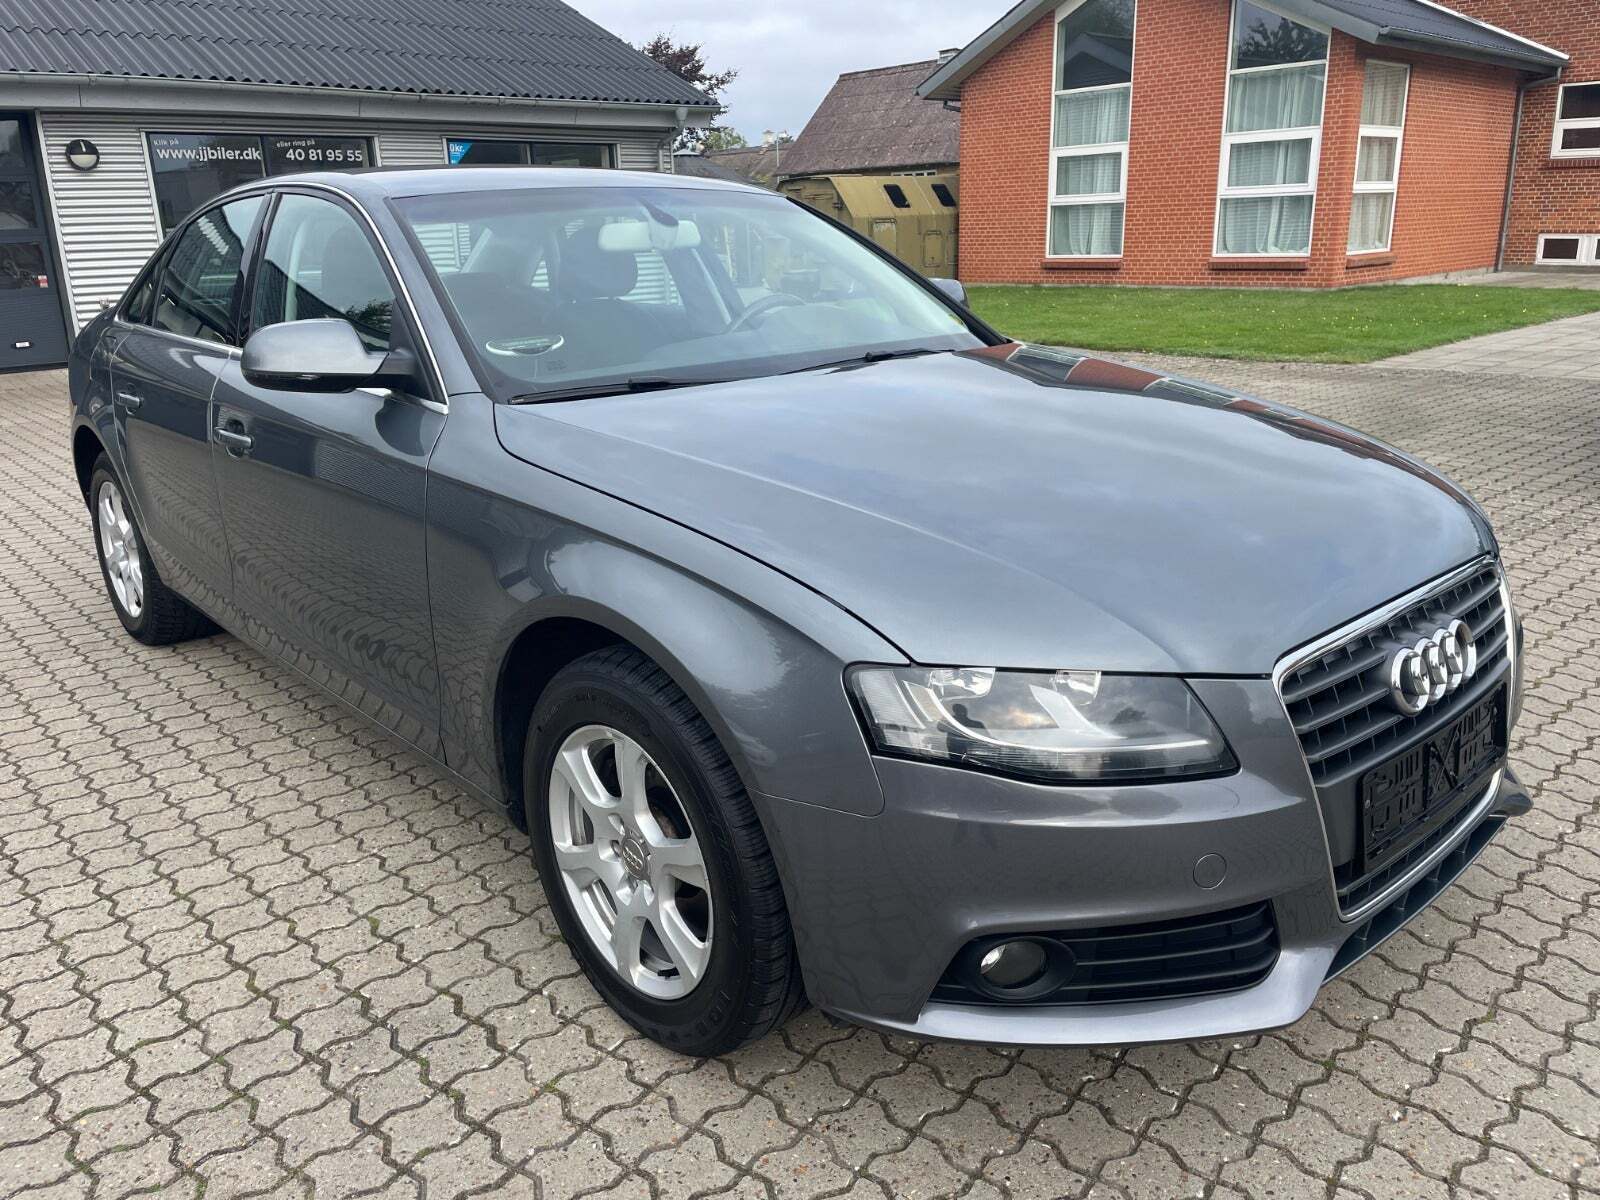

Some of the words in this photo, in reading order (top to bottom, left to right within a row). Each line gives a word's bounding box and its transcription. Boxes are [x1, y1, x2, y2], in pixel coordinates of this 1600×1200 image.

[307, 138, 315, 146] på
[156, 147, 262, 161] www.jjbiler.dk
[286, 148, 305, 161] 40
[308, 149, 323, 161] 81
[325, 149, 343, 161] 95
[346, 150, 363, 161] 55
